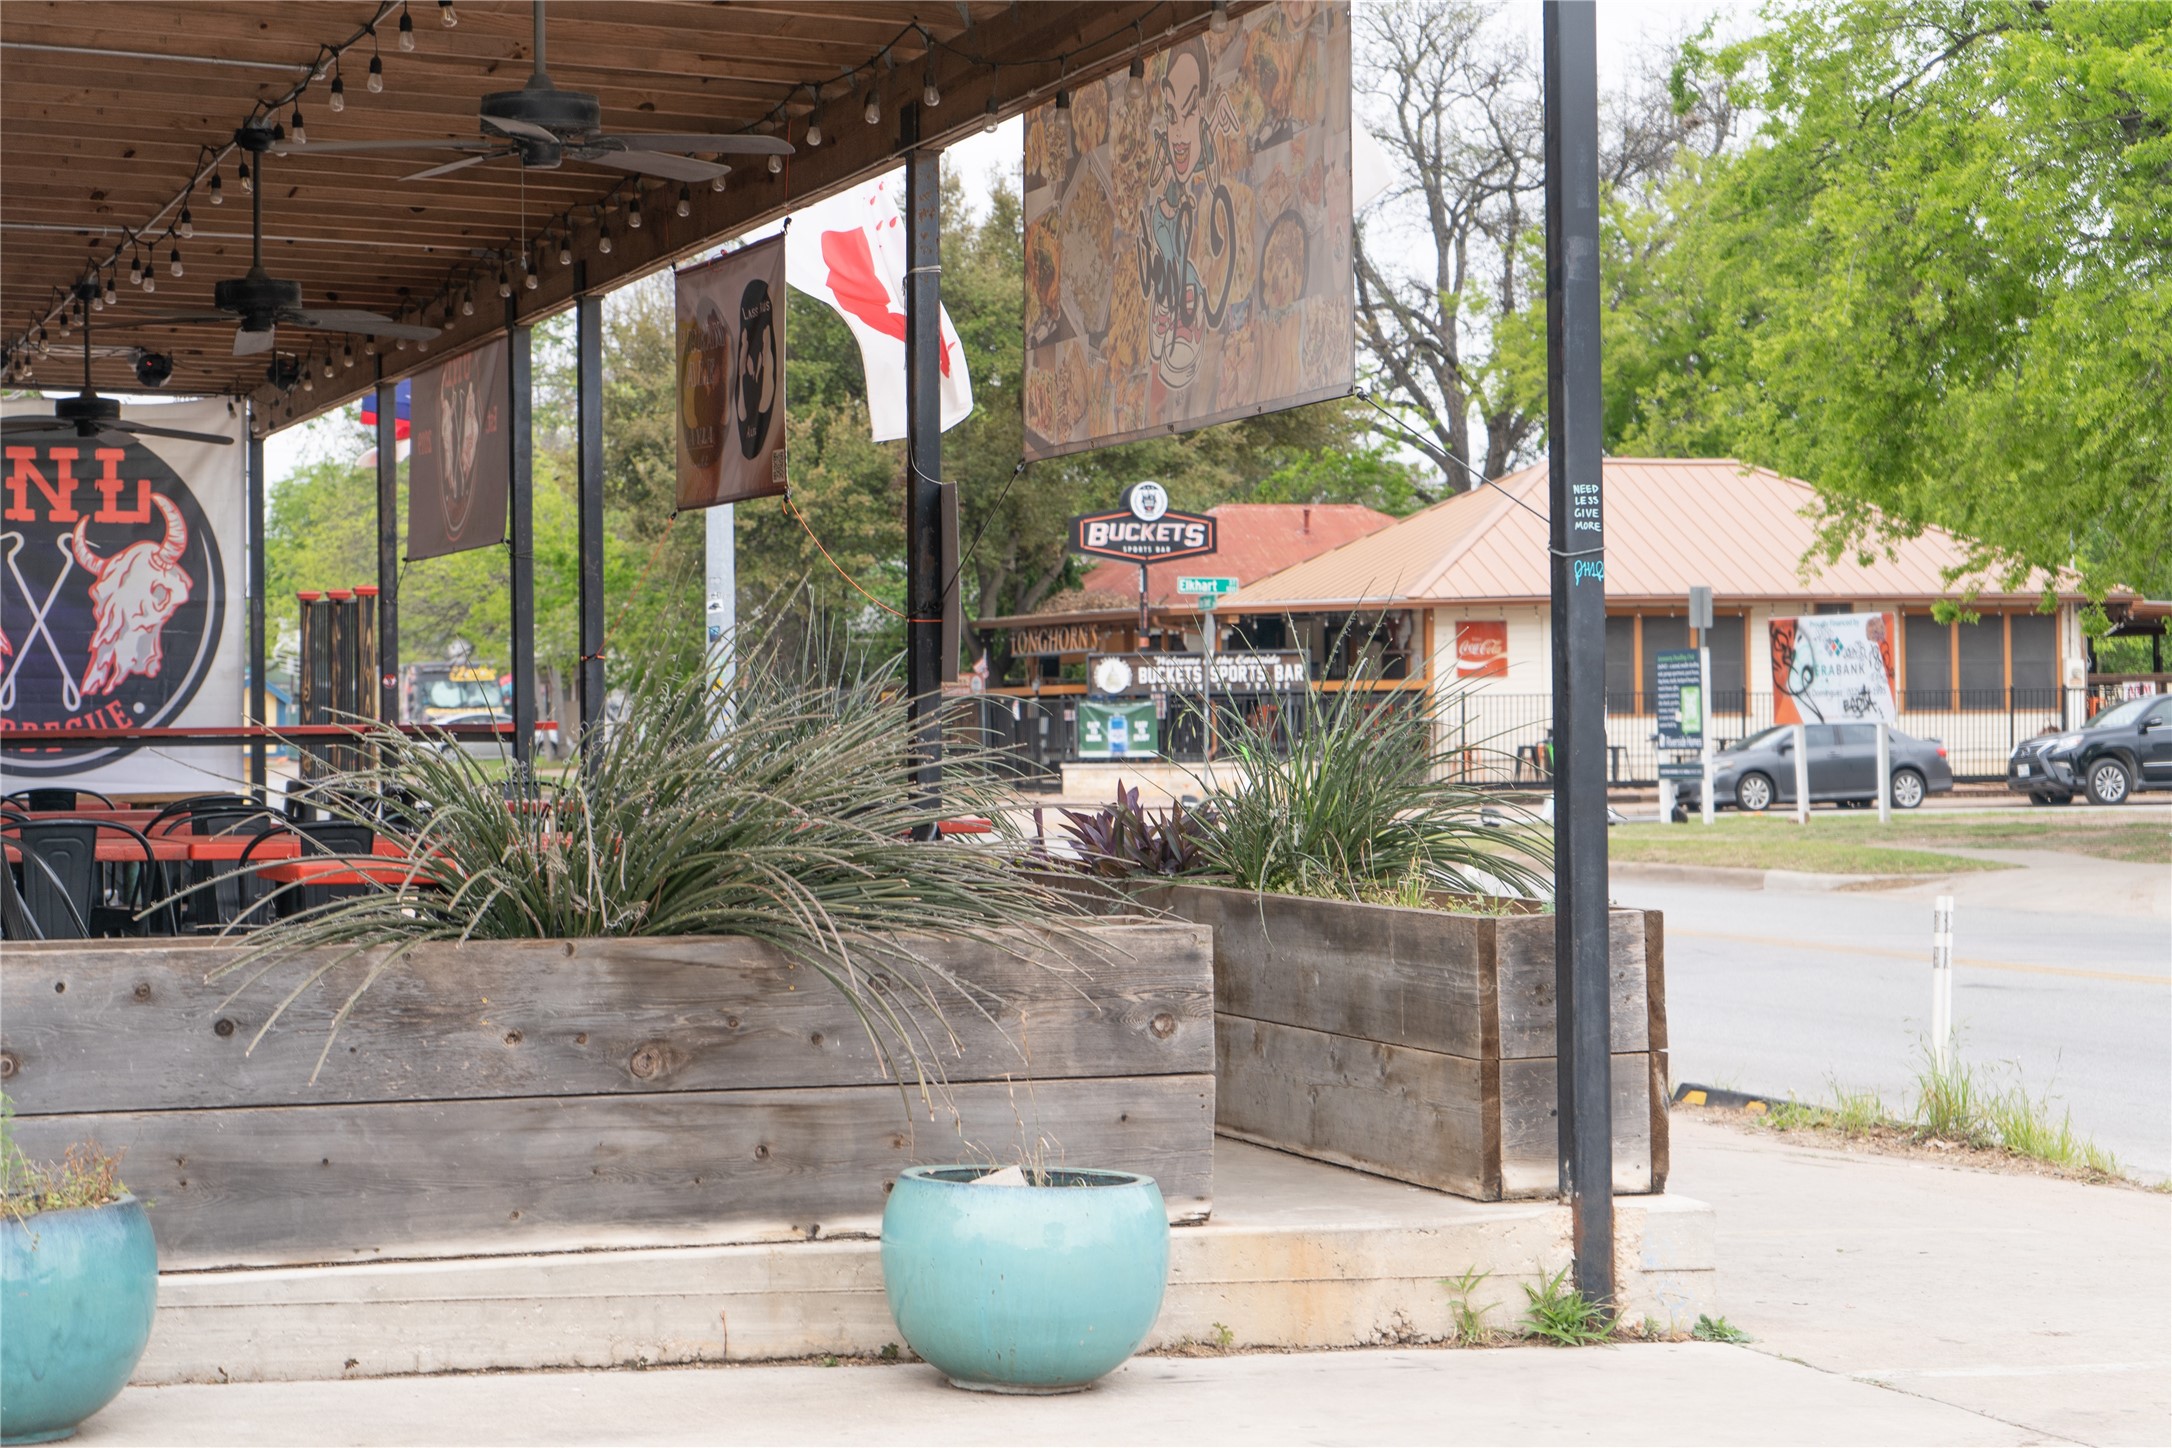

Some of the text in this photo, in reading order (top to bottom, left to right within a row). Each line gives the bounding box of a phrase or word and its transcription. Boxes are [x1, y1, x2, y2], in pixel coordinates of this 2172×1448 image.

[1572, 484, 1599, 494] NEED
[1575, 496, 1599, 506] LESS
[1574, 508, 1599, 518] GIVE
[1575, 521, 1602, 532] MORE
[1088, 522, 1206, 547] BUCKETS
[1180, 579, 1217, 592] Elkhart
[1138, 663, 1304, 684] BUCKETS SPORTS BAR
[1804, 664, 1866, 678] ERABANK
